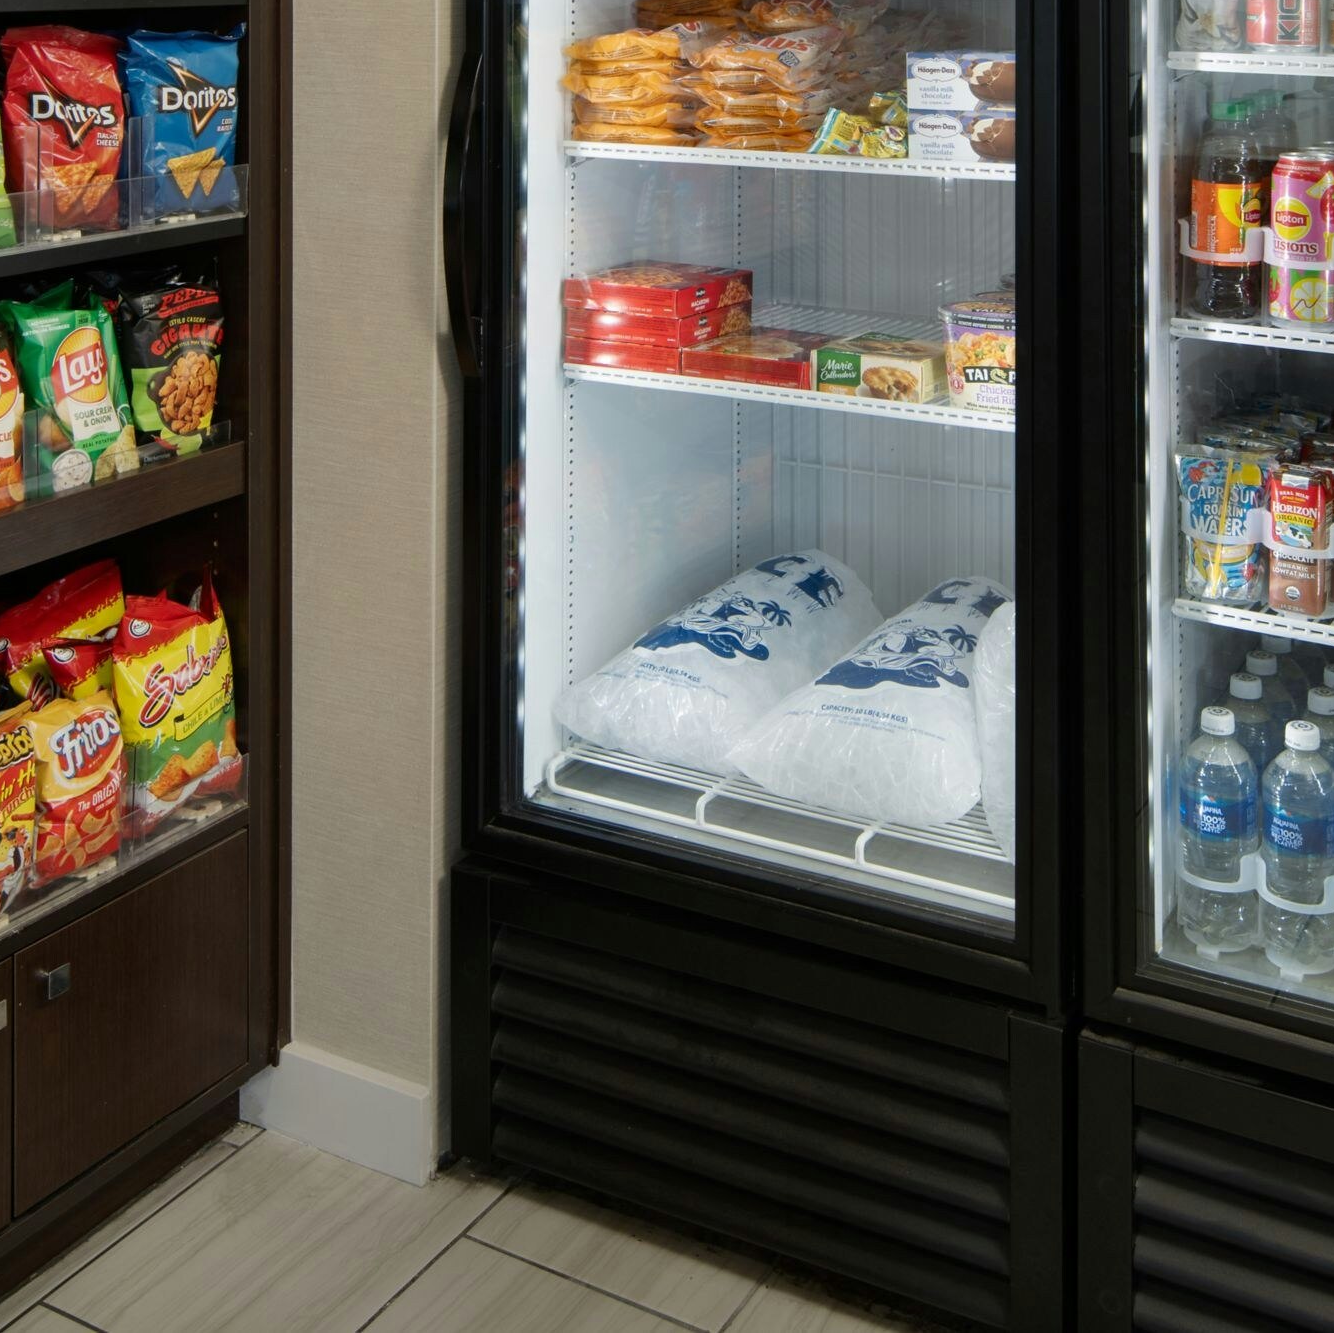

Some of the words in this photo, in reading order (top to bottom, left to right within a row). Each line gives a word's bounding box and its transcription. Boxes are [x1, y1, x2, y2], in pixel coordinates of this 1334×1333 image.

[162, 86, 236, 111] Doritos
[31, 93, 115, 126] Doritos
[1275, 213, 1305, 225] Lipton
[824, 358, 854, 371] Marie
[74, 409, 93, 420] SOUR
[90, 415, 112, 426] ONION
[1273, 501, 1318, 519] HORIZON
[1276, 513, 1313, 526] ORGANIC
[50, 710, 121, 779] Fritos
